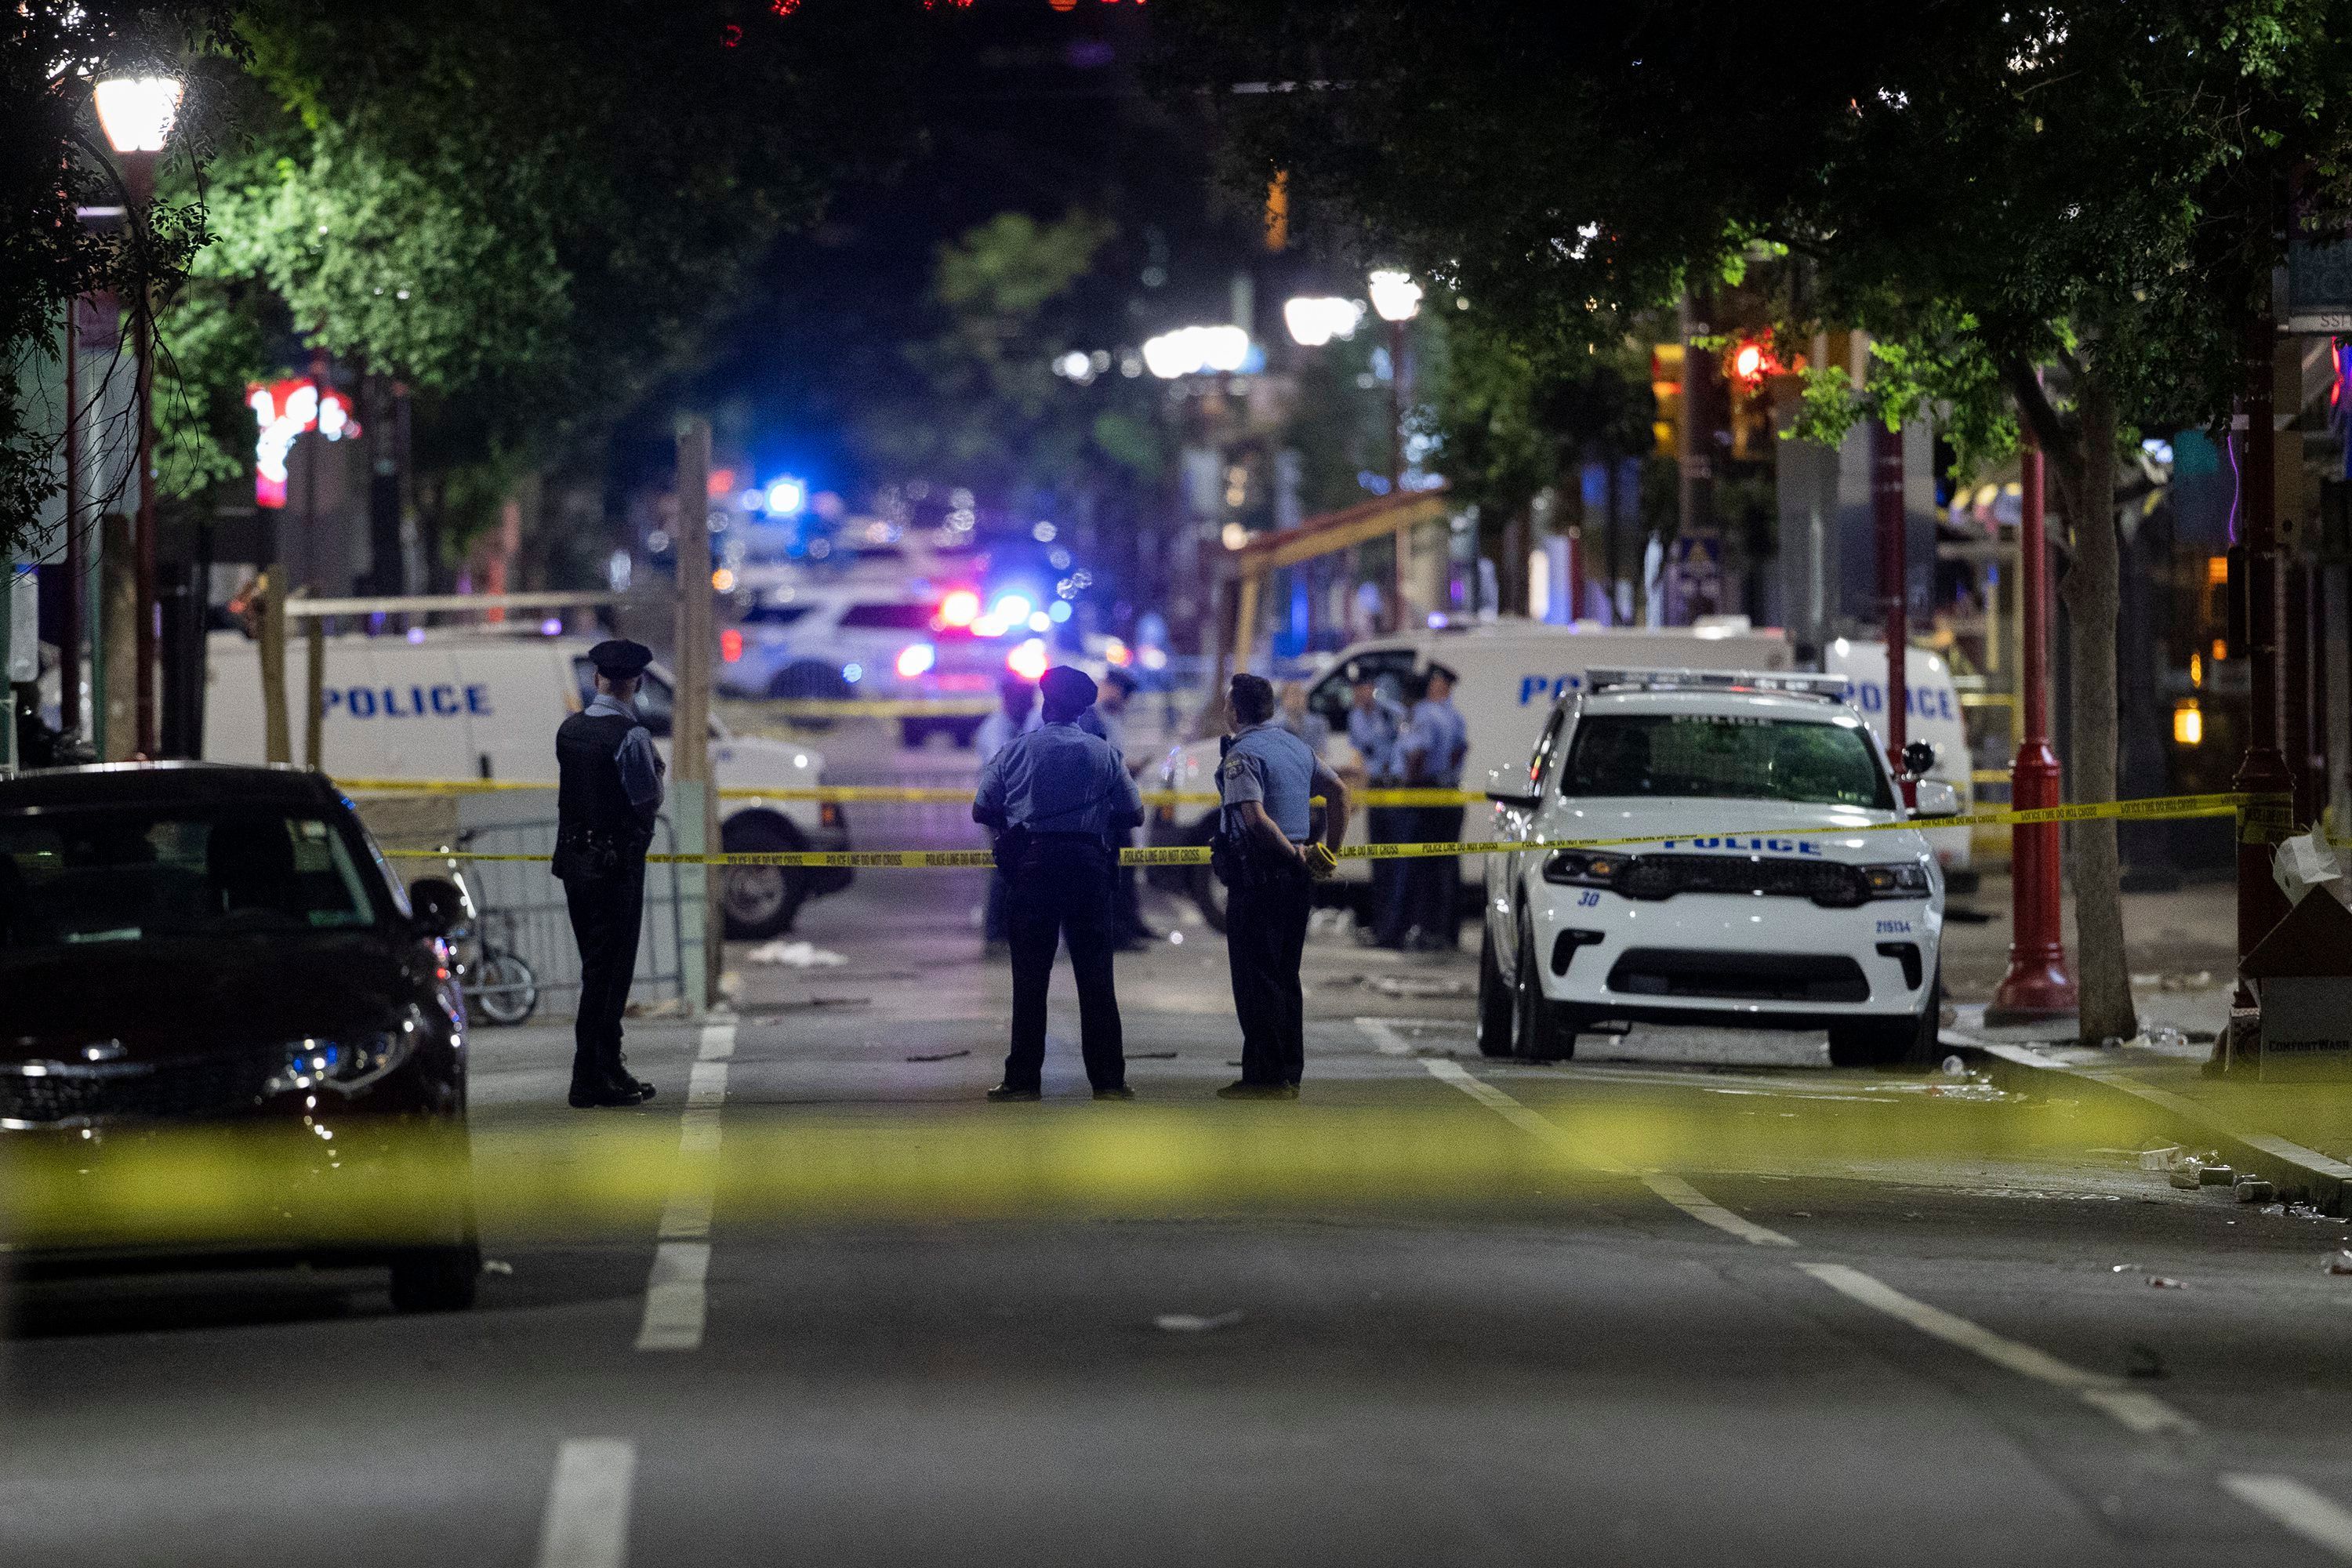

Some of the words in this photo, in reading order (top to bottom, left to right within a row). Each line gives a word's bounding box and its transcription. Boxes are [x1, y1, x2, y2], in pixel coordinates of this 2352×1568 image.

[320, 684, 492, 719] POLICE
[1837, 681, 1953, 720] POICE
[1343, 846, 1356, 856] LINE
[1357, 846, 1366, 855] DO
[1367, 845, 1378, 855] NOT
[1379, 845, 1399, 855] CROSS
[1422, 843, 1443, 853] POLICE
[1443, 843, 1456, 852] LINE
[1457, 843, 1465, 851] DO
[826, 855, 846, 865] POLICE
[847, 855, 859, 865] LINE
[860, 855, 870, 865] DO
[870, 855, 882, 865] NOT
[883, 855, 902, 866] CROSS
[926, 854, 946, 866] POLICE
[946, 854, 959, 866] LINE
[960, 853, 969, 866] DO
[970, 853, 981, 866] NOT
[1124, 850, 1144, 862] POLICE
[1145, 850, 1157, 862] LINE
[1158, 850, 1167, 862] DO
[1168, 850, 1179, 862] NOT
[1180, 849, 1200, 862] CROSS
[1577, 891, 1600, 907] 30
